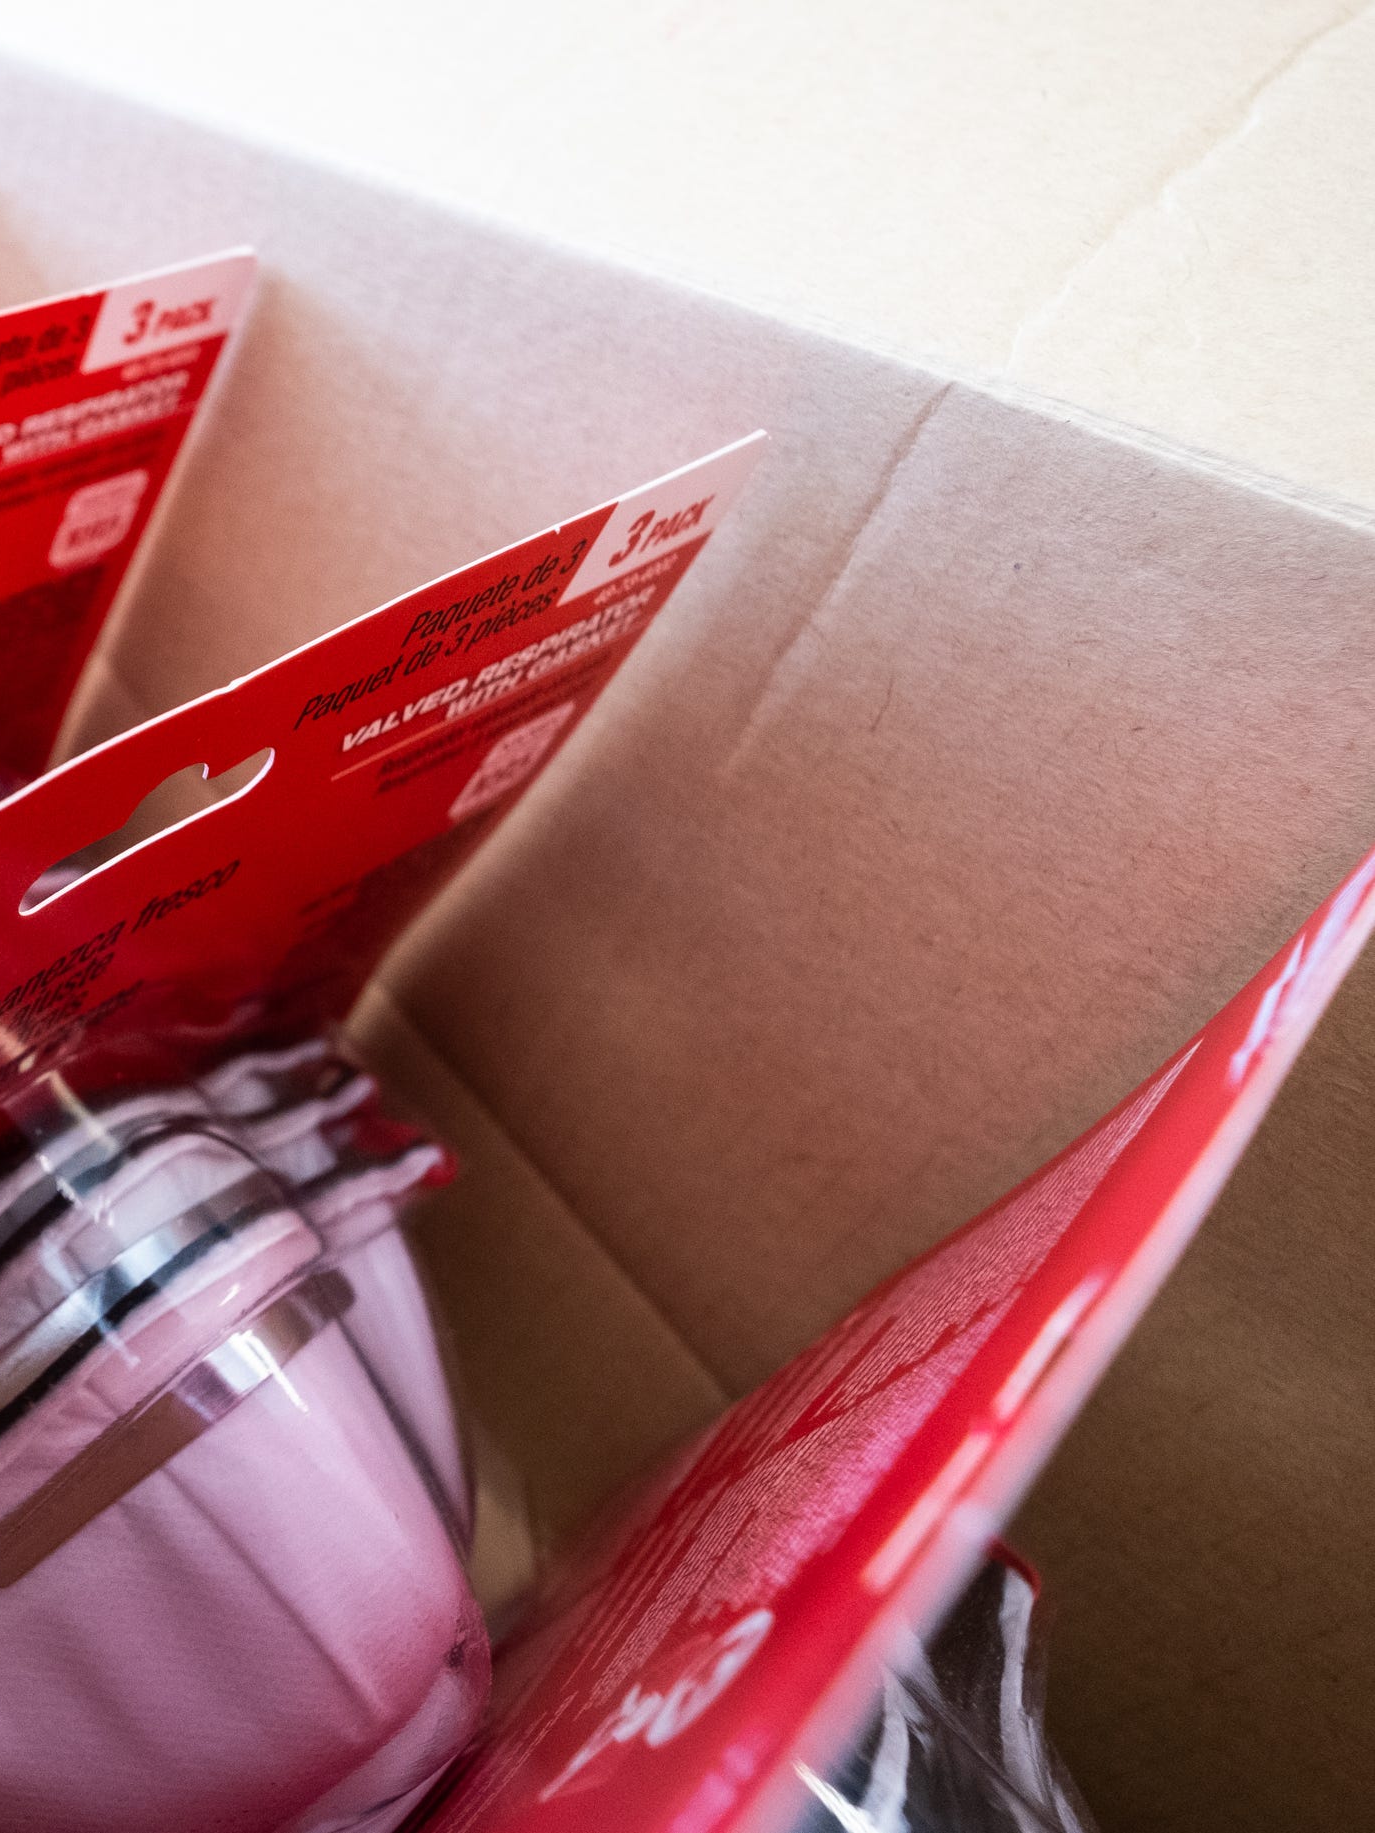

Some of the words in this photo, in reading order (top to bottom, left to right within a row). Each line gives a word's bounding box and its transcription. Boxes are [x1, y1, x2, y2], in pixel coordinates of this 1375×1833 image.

[123, 299, 154, 346] 3
[609, 510, 656, 568] 3
[639, 494, 716, 554] PACK
[401, 570, 521, 648] Paquete
[521, 554, 559, 592] de
[560, 538, 587, 575] 3
[294, 656, 404, 731] Paquet
[403, 640, 442, 678] de
[444, 626, 471, 657] 3
[342, 678, 468, 753] VALVED
[131, 860, 240, 934] fresco
